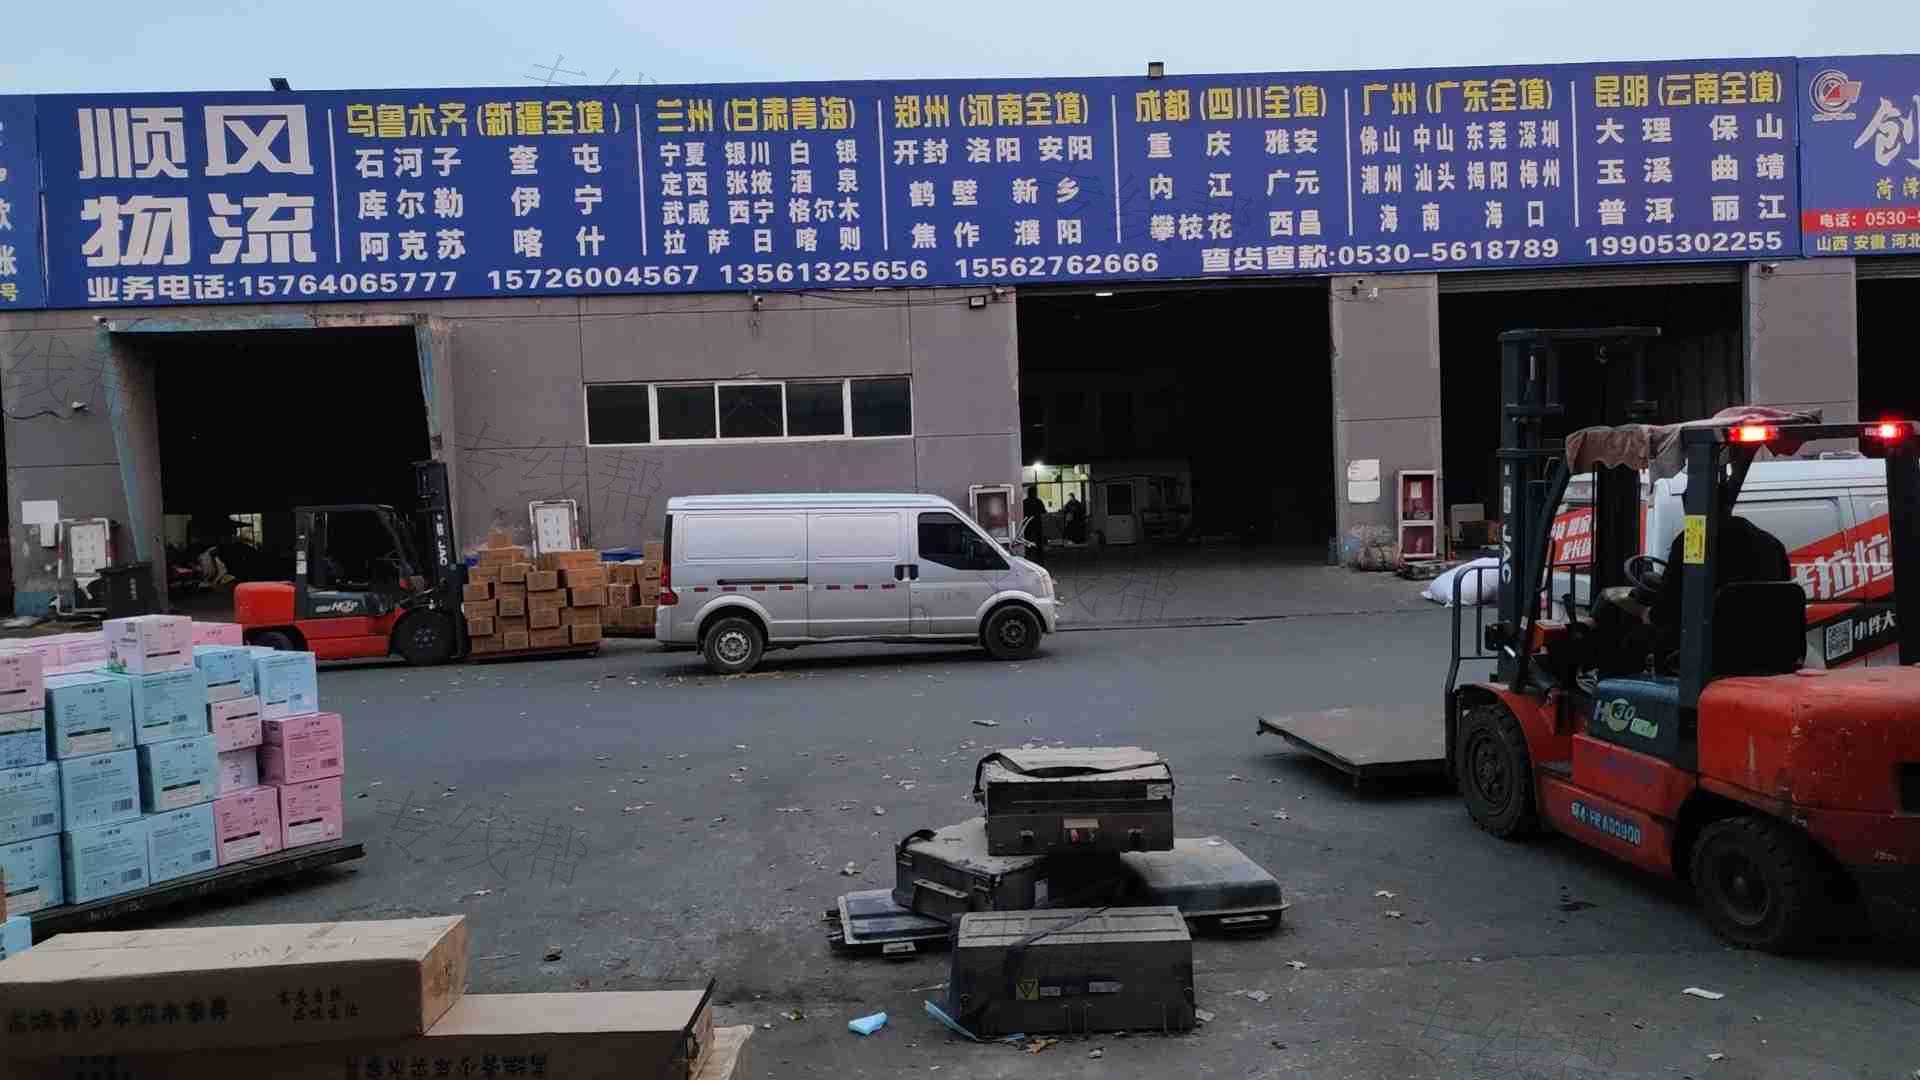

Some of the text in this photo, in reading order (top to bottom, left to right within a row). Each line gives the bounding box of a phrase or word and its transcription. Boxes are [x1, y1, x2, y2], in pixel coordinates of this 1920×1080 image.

[79, 105, 313, 178] 顺风
[1148, 128, 1317, 158] 重庆 雅安
[1360, 120, 1559, 154] 佛山 中山 东莞 深圳
[1597, 113, 1782, 144] 大理 保山
[356, 144, 601, 177] 石河子 奎屯
[661, 140, 856, 166] 宁夏 银川 白银
[894, 136, 1092, 164] 开封 洛阳 安阳
[662, 168, 857, 195] 定西 张掖 酒泉
[1362, 159, 1559, 193] 潮州 汕头 揭阳 梅州
[1598, 153, 1784, 184] 玉溪 曲靖
[910, 178, 1078, 206] 鹤壁 新乡
[1151, 170, 1319, 199] 内江 广元
[359, 185, 601, 219] 库尔勒 伊宁
[663, 197, 859, 225] 武威 西宁 格尔木
[1380, 200, 1543, 232] 海南 海口
[1598, 195, 1786, 225] 普洱 丽江
[81, 193, 316, 266] 物流
[912, 220, 1081, 248] 焦作 濮阳
[1151, 210, 1320, 240] 攀枝花 西昌
[361, 226, 604, 261] 阿克苏 喀什
[88, 232, 1781, 301] 业务电话:15764065777 15726004567 13561325656 15562762666 查货查款:0530-5618789 19905302255
